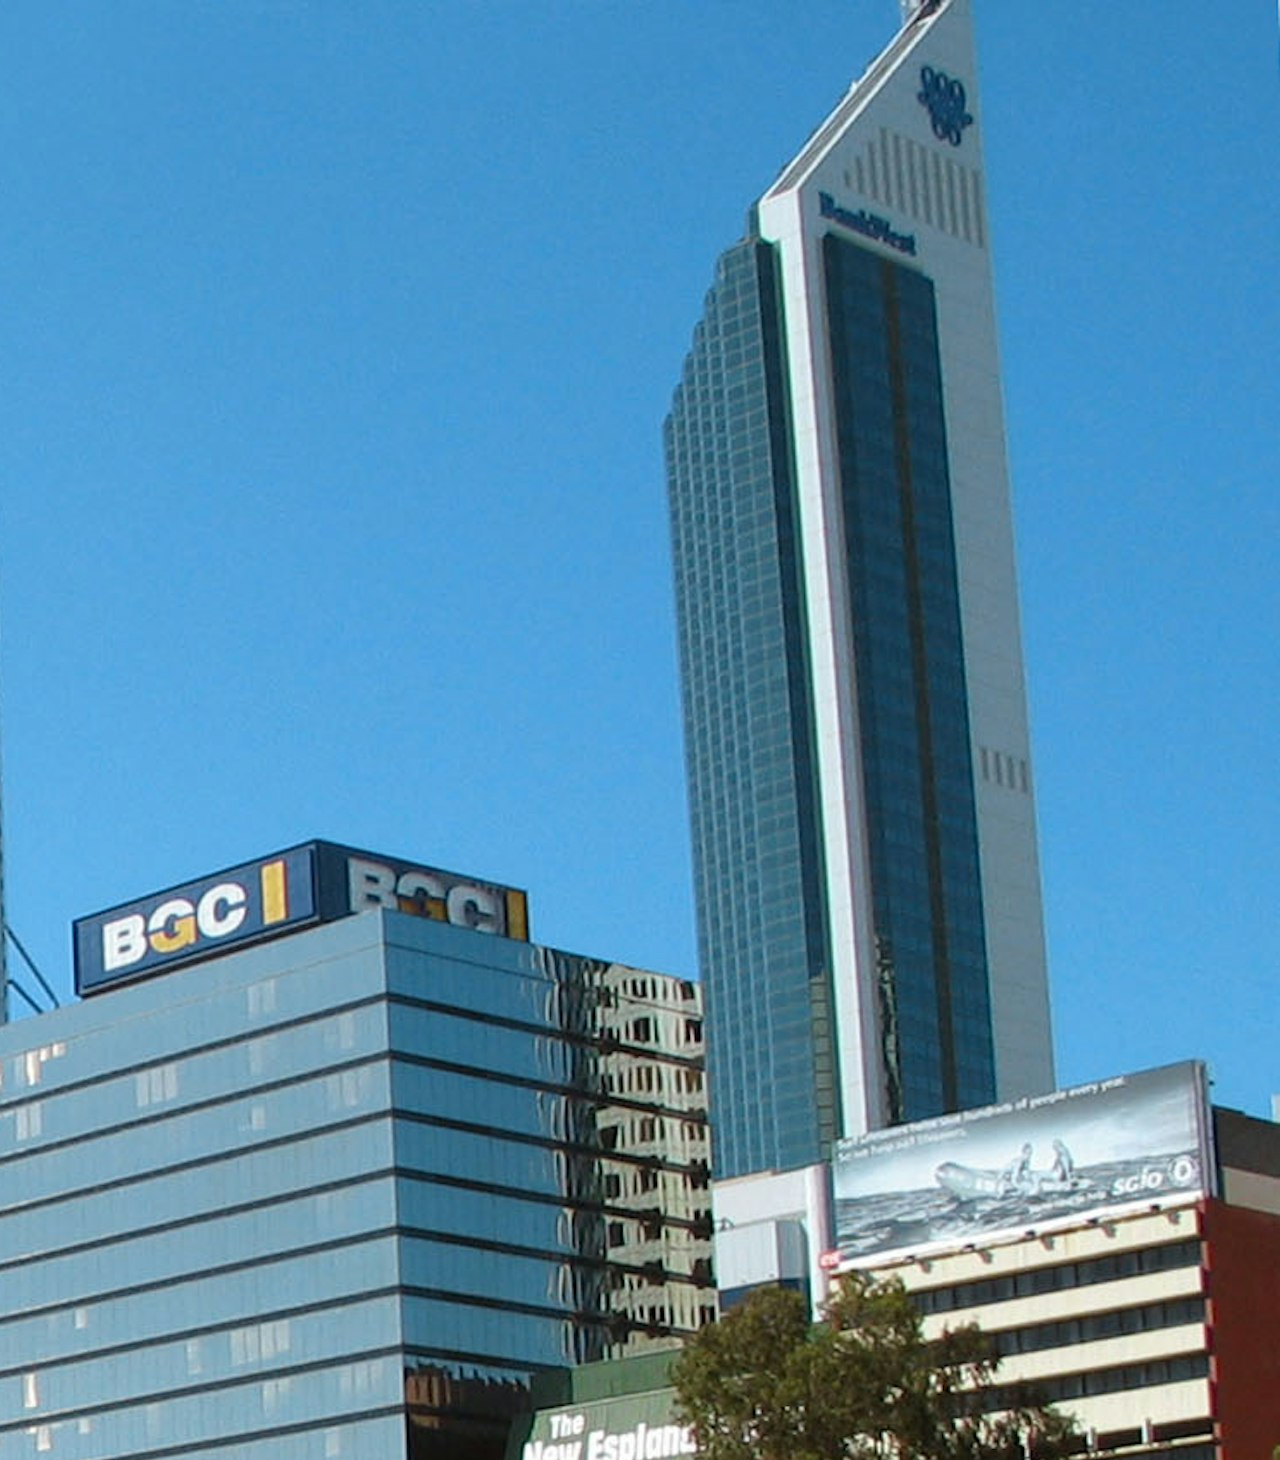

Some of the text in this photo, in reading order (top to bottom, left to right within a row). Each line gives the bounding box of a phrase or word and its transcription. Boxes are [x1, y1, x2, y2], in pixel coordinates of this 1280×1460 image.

[103, 882, 247, 972] BGC
[348, 857, 500, 936] BGC
[550, 1413, 585, 1439] The
